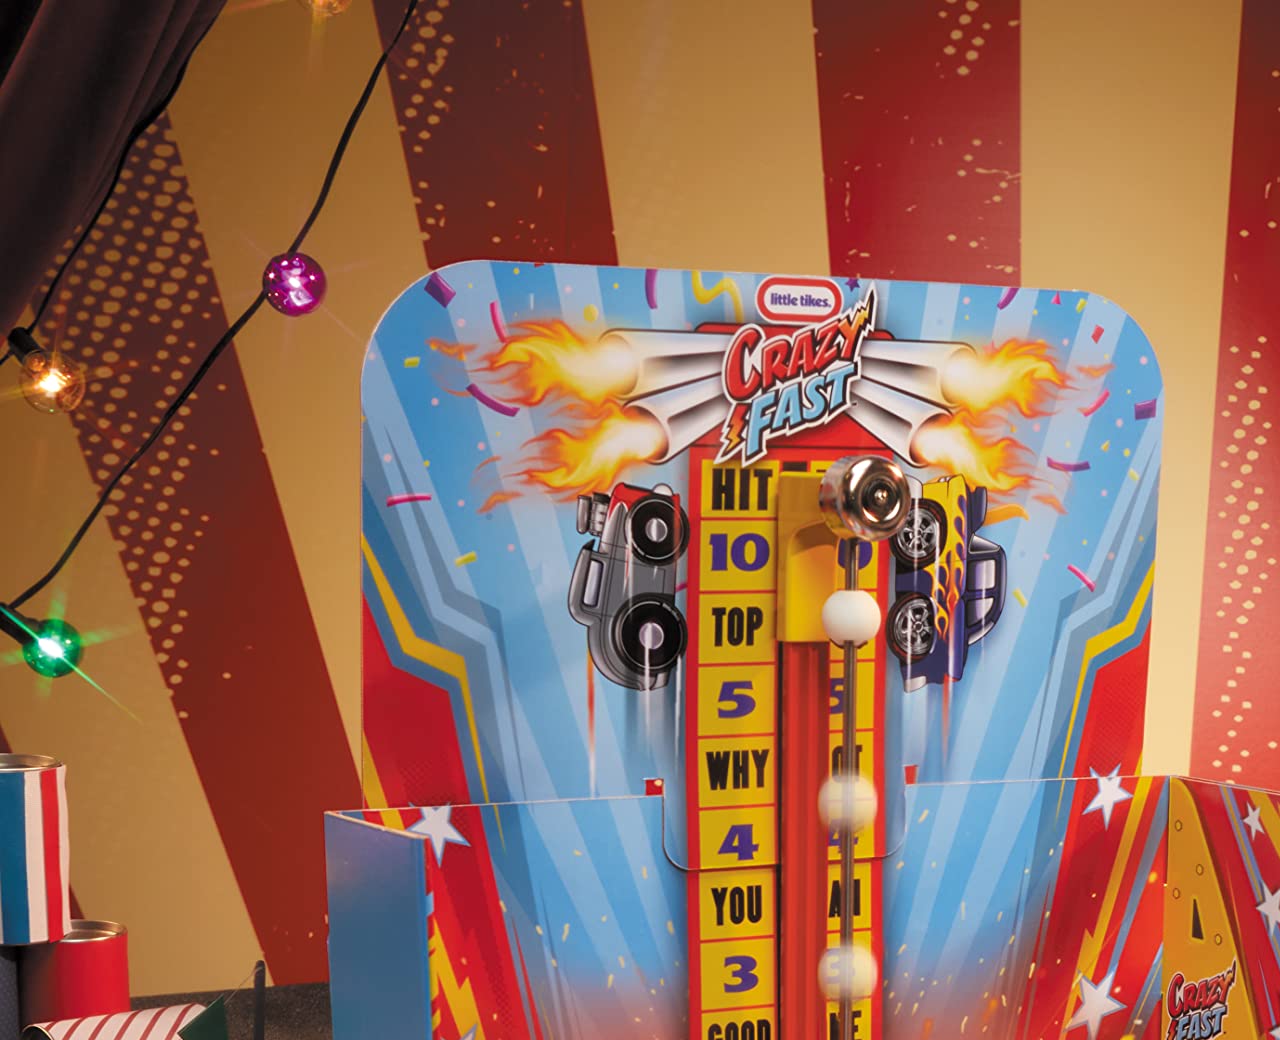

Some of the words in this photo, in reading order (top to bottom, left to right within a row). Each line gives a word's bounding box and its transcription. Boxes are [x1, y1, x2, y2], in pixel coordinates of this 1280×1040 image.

[770, 293, 798, 306] little
[725, 289, 874, 400] CRAZY
[746, 363, 856, 457] FAST
[711, 467, 773, 511] HIT
[709, 533, 770, 571] 10
[711, 606, 764, 647] TOP
[717, 680, 757, 719] 5
[706, 749, 770, 790] WHY
[717, 823, 760, 861] 4
[711, 884, 763, 926] YOU
[723, 955, 759, 993] 3
[1167, 960, 1237, 1018] CRAZY
